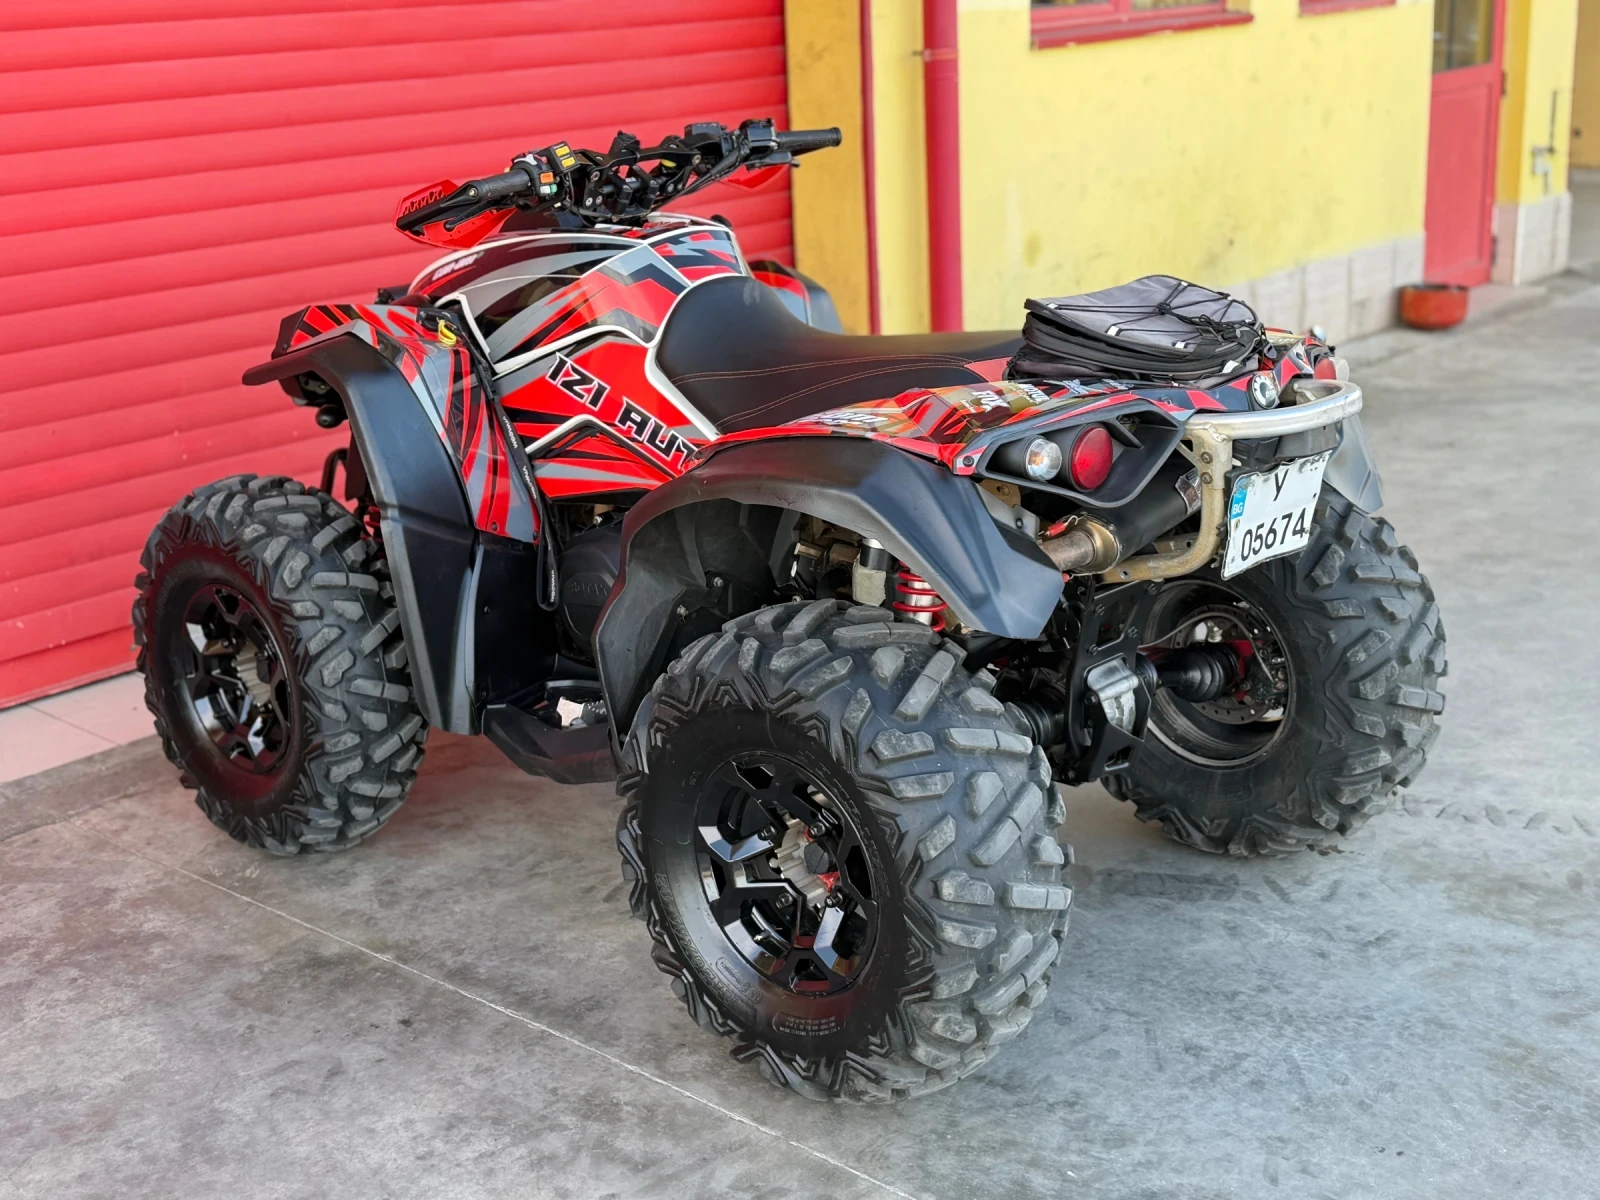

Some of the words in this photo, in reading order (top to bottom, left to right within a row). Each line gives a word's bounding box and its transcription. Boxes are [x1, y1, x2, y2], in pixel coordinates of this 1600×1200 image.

[546, 352, 611, 411] IZI
[1274, 468, 1289, 501] Y
[1233, 501, 1244, 514] BG
[1240, 507, 1307, 562] 05674
